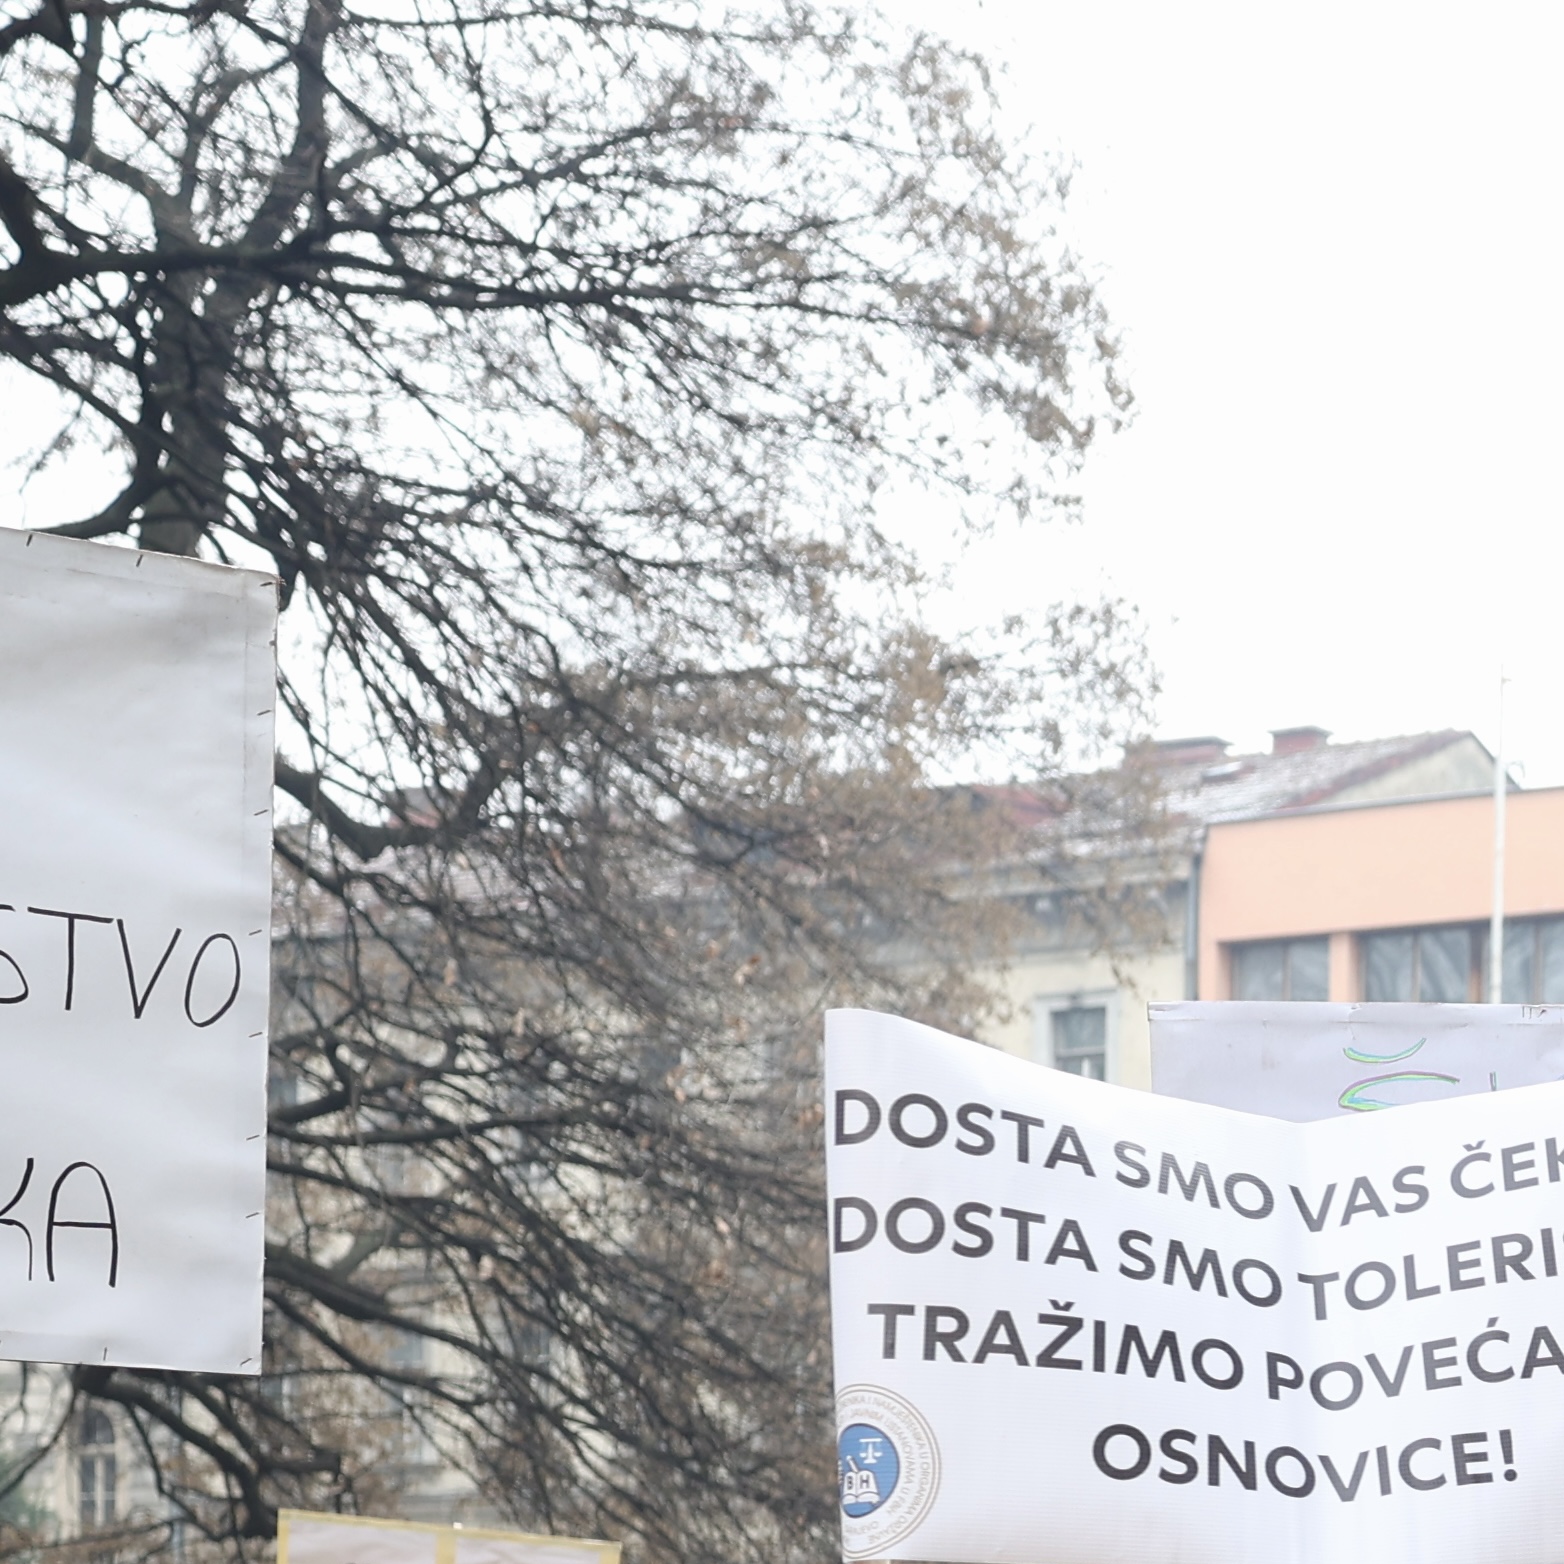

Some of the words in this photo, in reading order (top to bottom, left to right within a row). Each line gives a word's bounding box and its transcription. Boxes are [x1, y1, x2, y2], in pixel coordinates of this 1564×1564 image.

[834, 1089, 1097, 1177] DOSTA
[1114, 1141, 1274, 1219] SMO
[1288, 1165, 1429, 1232] VAS
[833, 1197, 1099, 1272] DOSTA
[1118, 1230, 1282, 1307] SMO
[867, 1303, 1244, 1390] TRAŽIMO
[1092, 1424, 1518, 1502] OSNOVICE!
